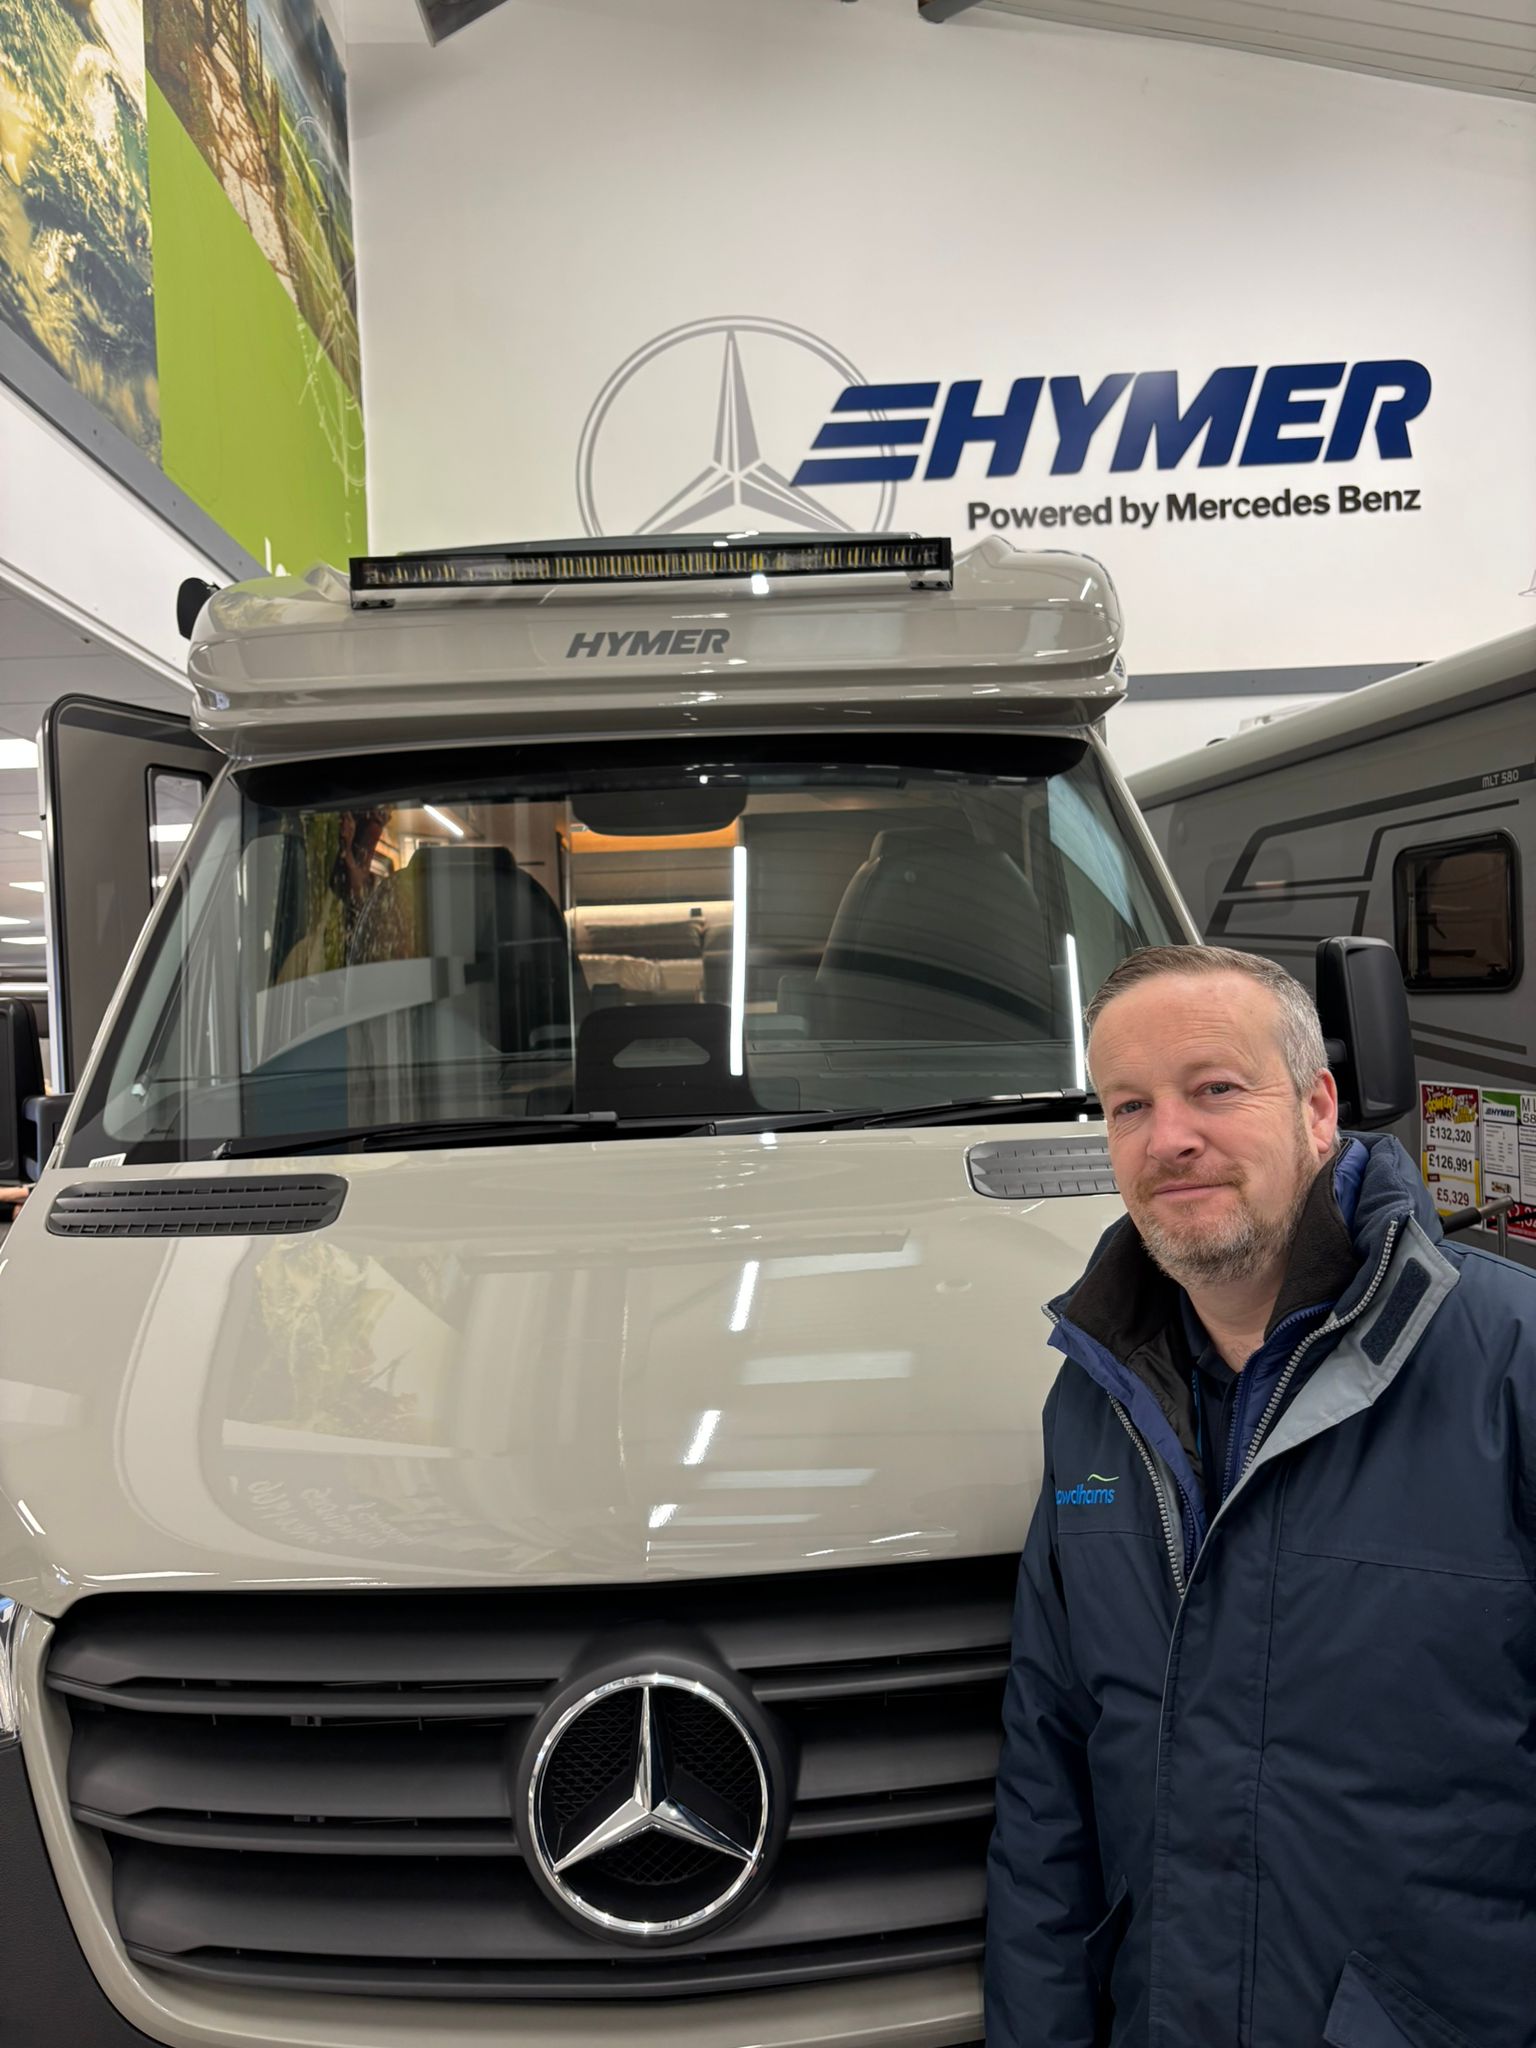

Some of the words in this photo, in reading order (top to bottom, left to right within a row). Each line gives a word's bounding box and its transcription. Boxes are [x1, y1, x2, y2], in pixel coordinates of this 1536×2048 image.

[922, 359, 1432, 480] HYMER
[968, 496, 1112, 530] Powered
[1120, 496, 1159, 529] by
[1166, 488, 1331, 522] Mercedes
[1338, 485, 1422, 513] Benz
[566, 628, 730, 658] HYMER
[1482, 773, 1500, 788] MLT
[1501, 769, 1519, 784] 580
[1430, 1125, 1472, 1144] £132,320
[1428, 1153, 1473, 1174] £126,991
[1436, 1187, 1470, 1207] £5,329
[1056, 1483, 1115, 1505] owdhams
